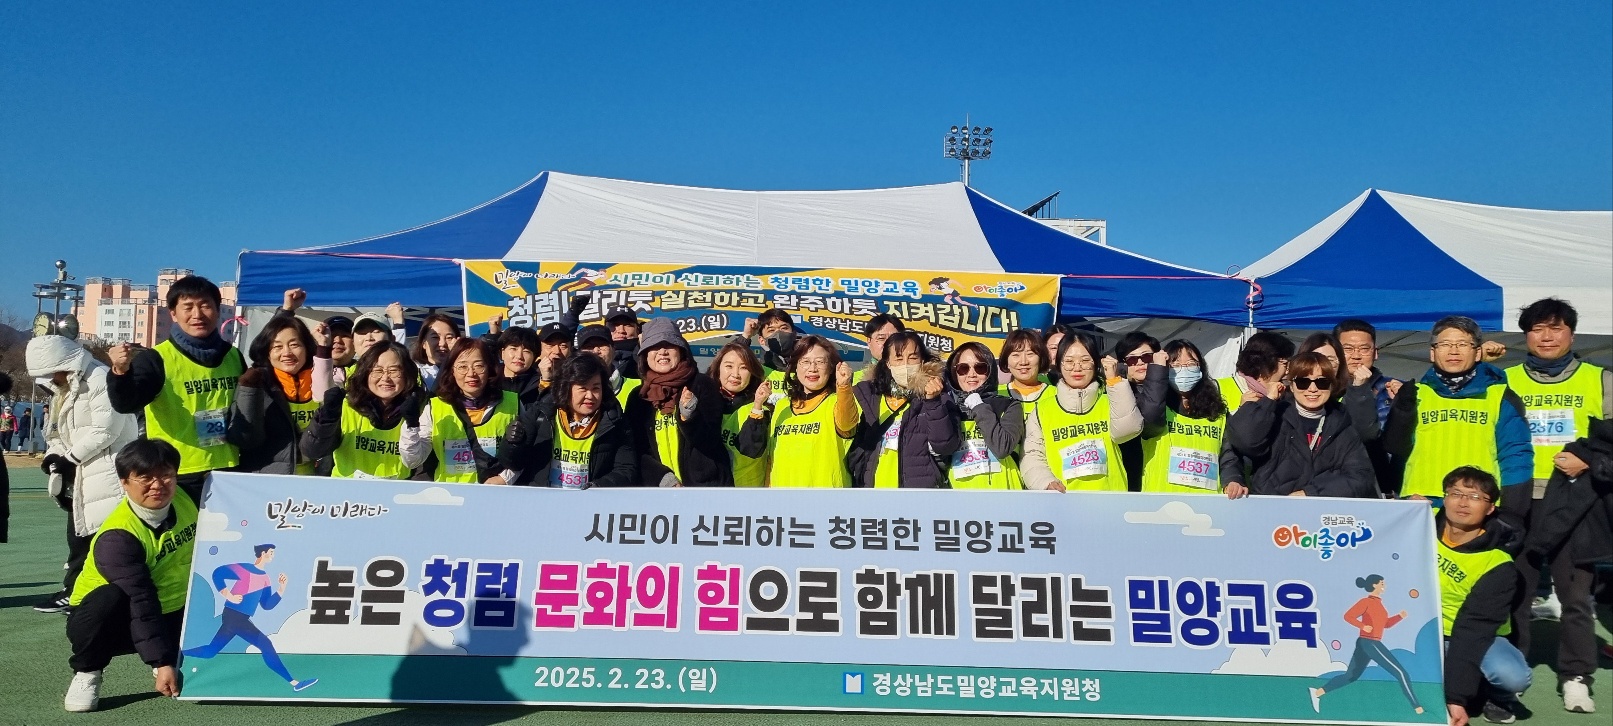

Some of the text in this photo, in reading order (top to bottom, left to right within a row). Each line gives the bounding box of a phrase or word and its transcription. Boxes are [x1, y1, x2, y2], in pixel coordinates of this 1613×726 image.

[609, 273, 921, 297] 시민이 신뢰하는 청렴한 밀양교육
[661, 290, 766, 308] 실천하고
[885, 301, 1019, 333] 지켜갑니다!
[1521, 394, 1584, 408] 양교육지원청
[1421, 408, 1488, 425] 밀양교육지원청
[1051, 420, 1109, 442] 밀양교육지원청
[1070, 450, 1099, 467] 4523
[1178, 460, 1210, 475] 4537
[558, 472, 588, 485] 4531
[267, 498, 389, 529] 밀양이 미래다
[1322, 515, 1355, 527] 경남교육
[585, 513, 1057, 555] 시민이 신뢰하는 청렴한 밀양교육
[1273, 524, 1373, 560] 아이좋아
[310, 558, 1318, 649] 높은 청렴 문화의 힘으로 함께 달리는 밀양교육
[534, 667, 602, 689] 2025.
[872, 672, 1101, 702] 경상남도밀양교육지원청
